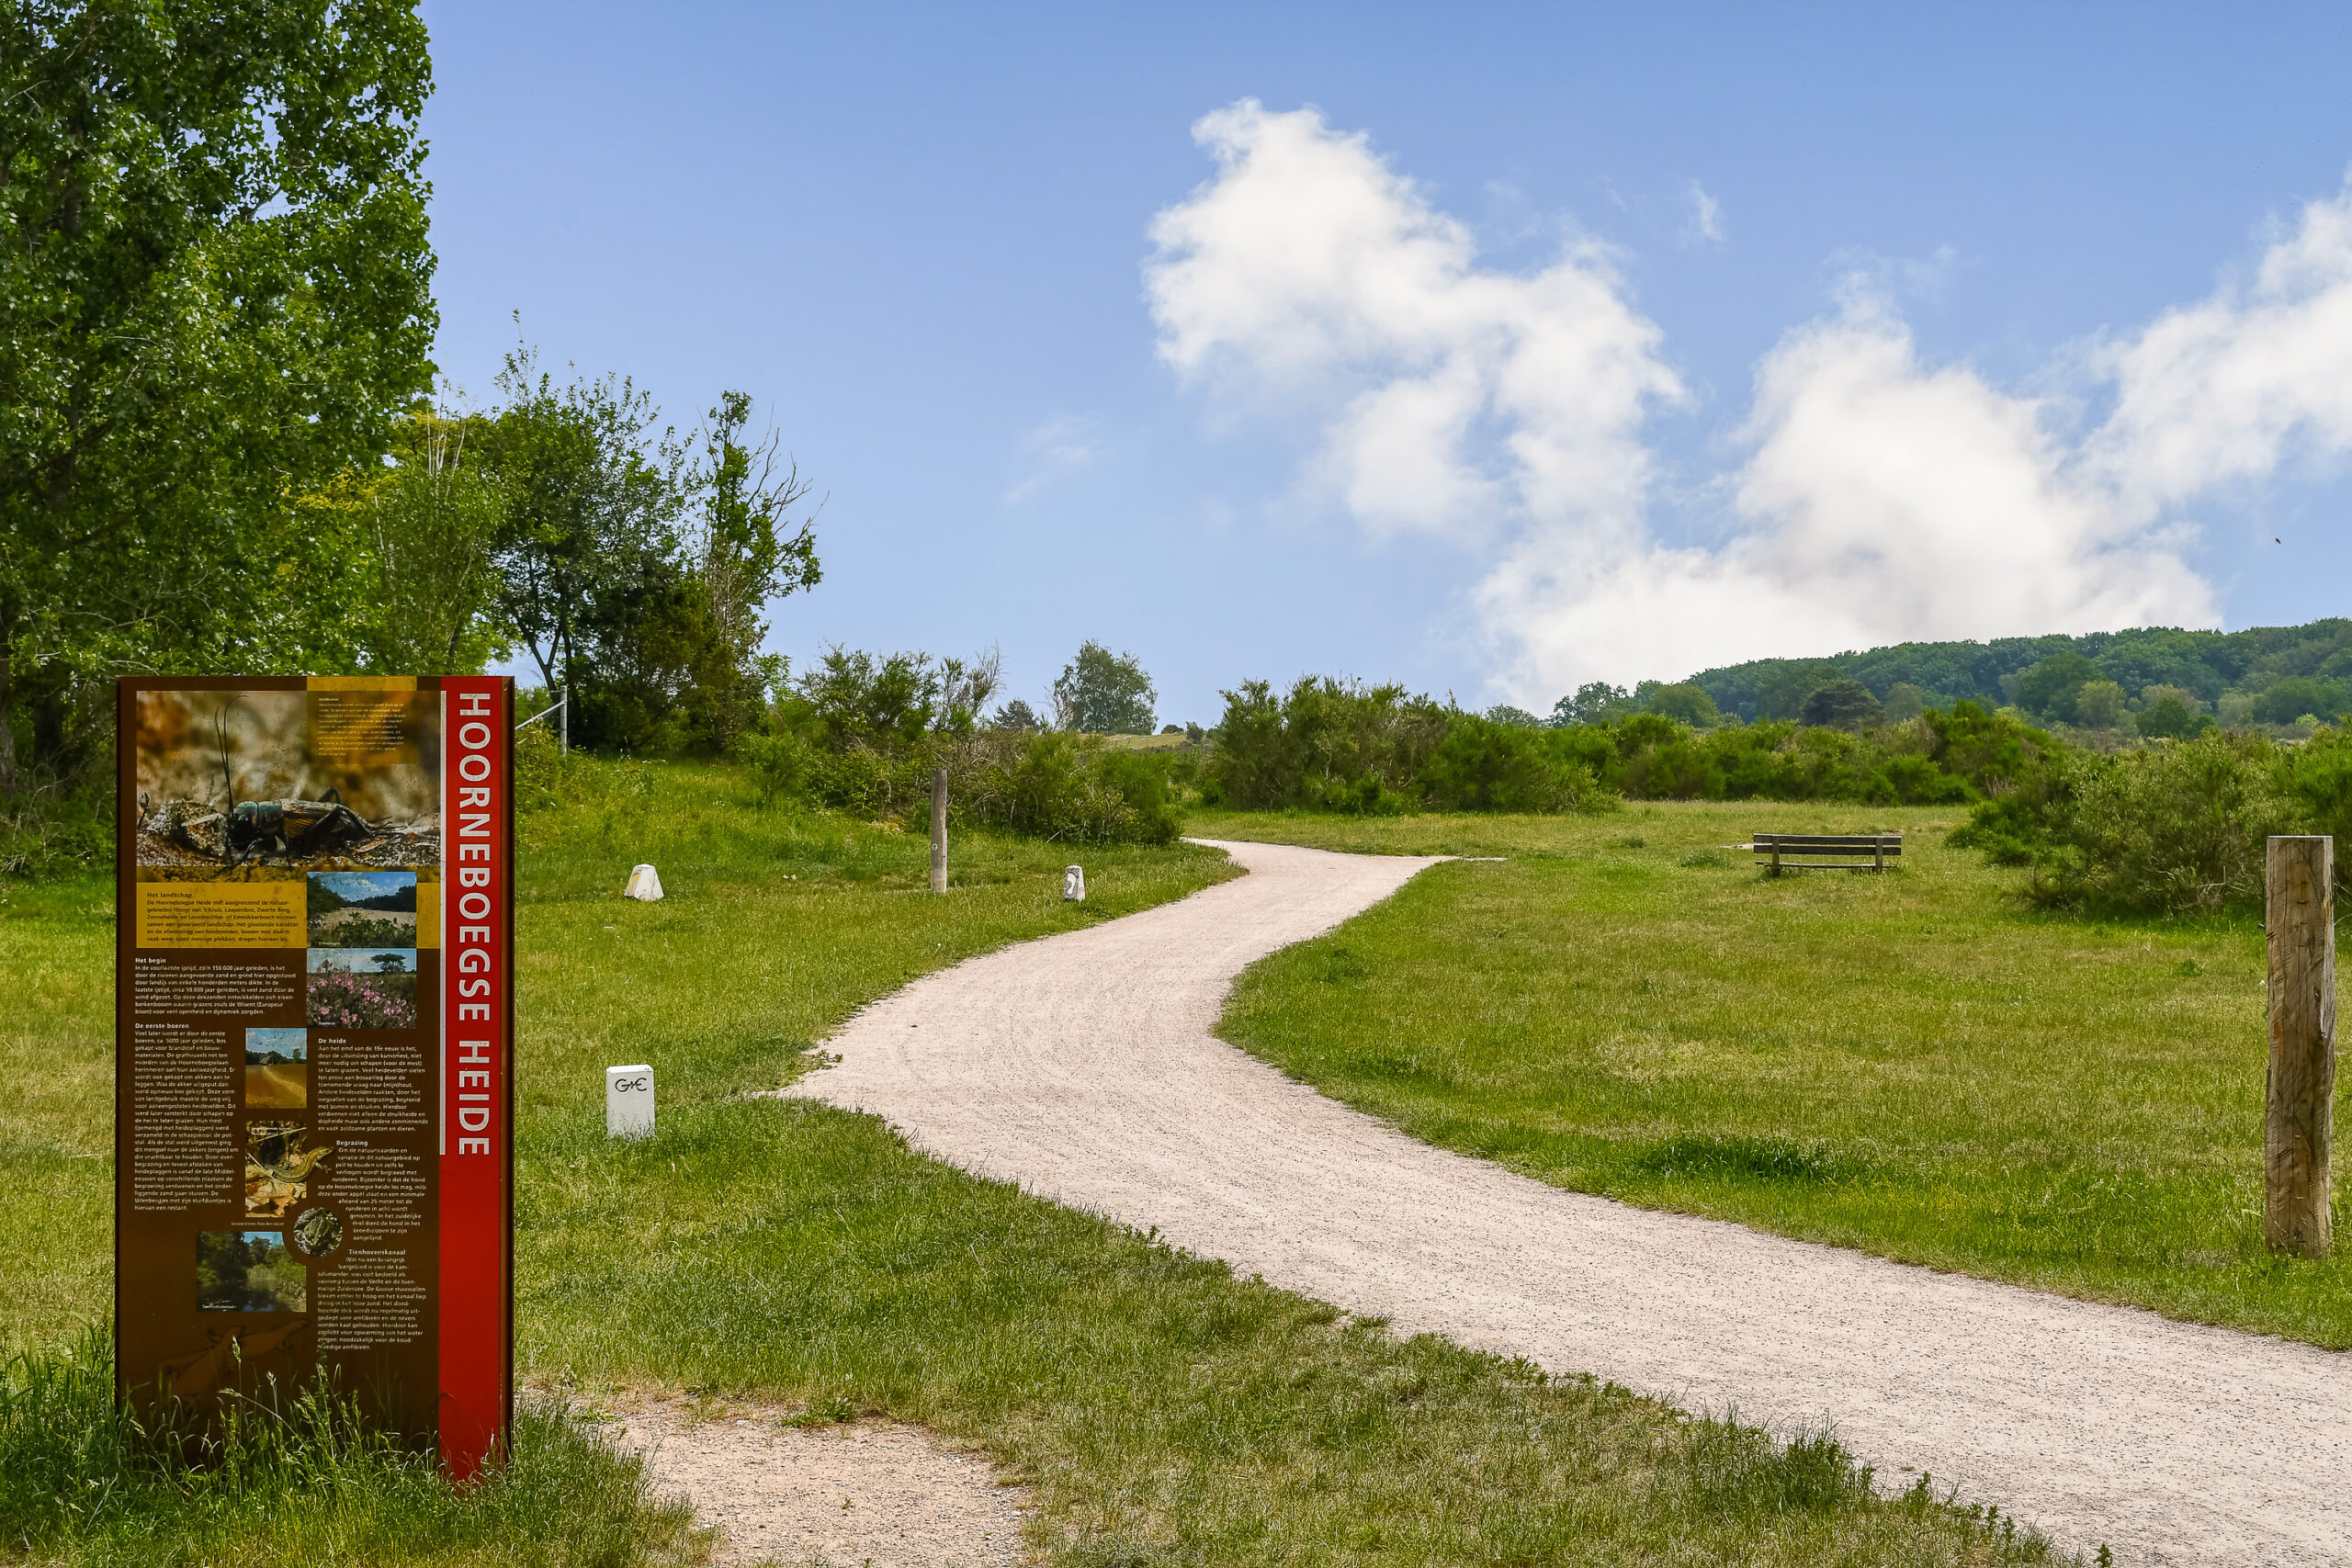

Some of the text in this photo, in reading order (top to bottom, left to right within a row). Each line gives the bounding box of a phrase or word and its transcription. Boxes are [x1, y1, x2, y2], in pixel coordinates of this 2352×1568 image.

[160, 891, 193, 899] landschap
[458, 693, 491, 1156] HOORNEBOEGSE HEIDE
